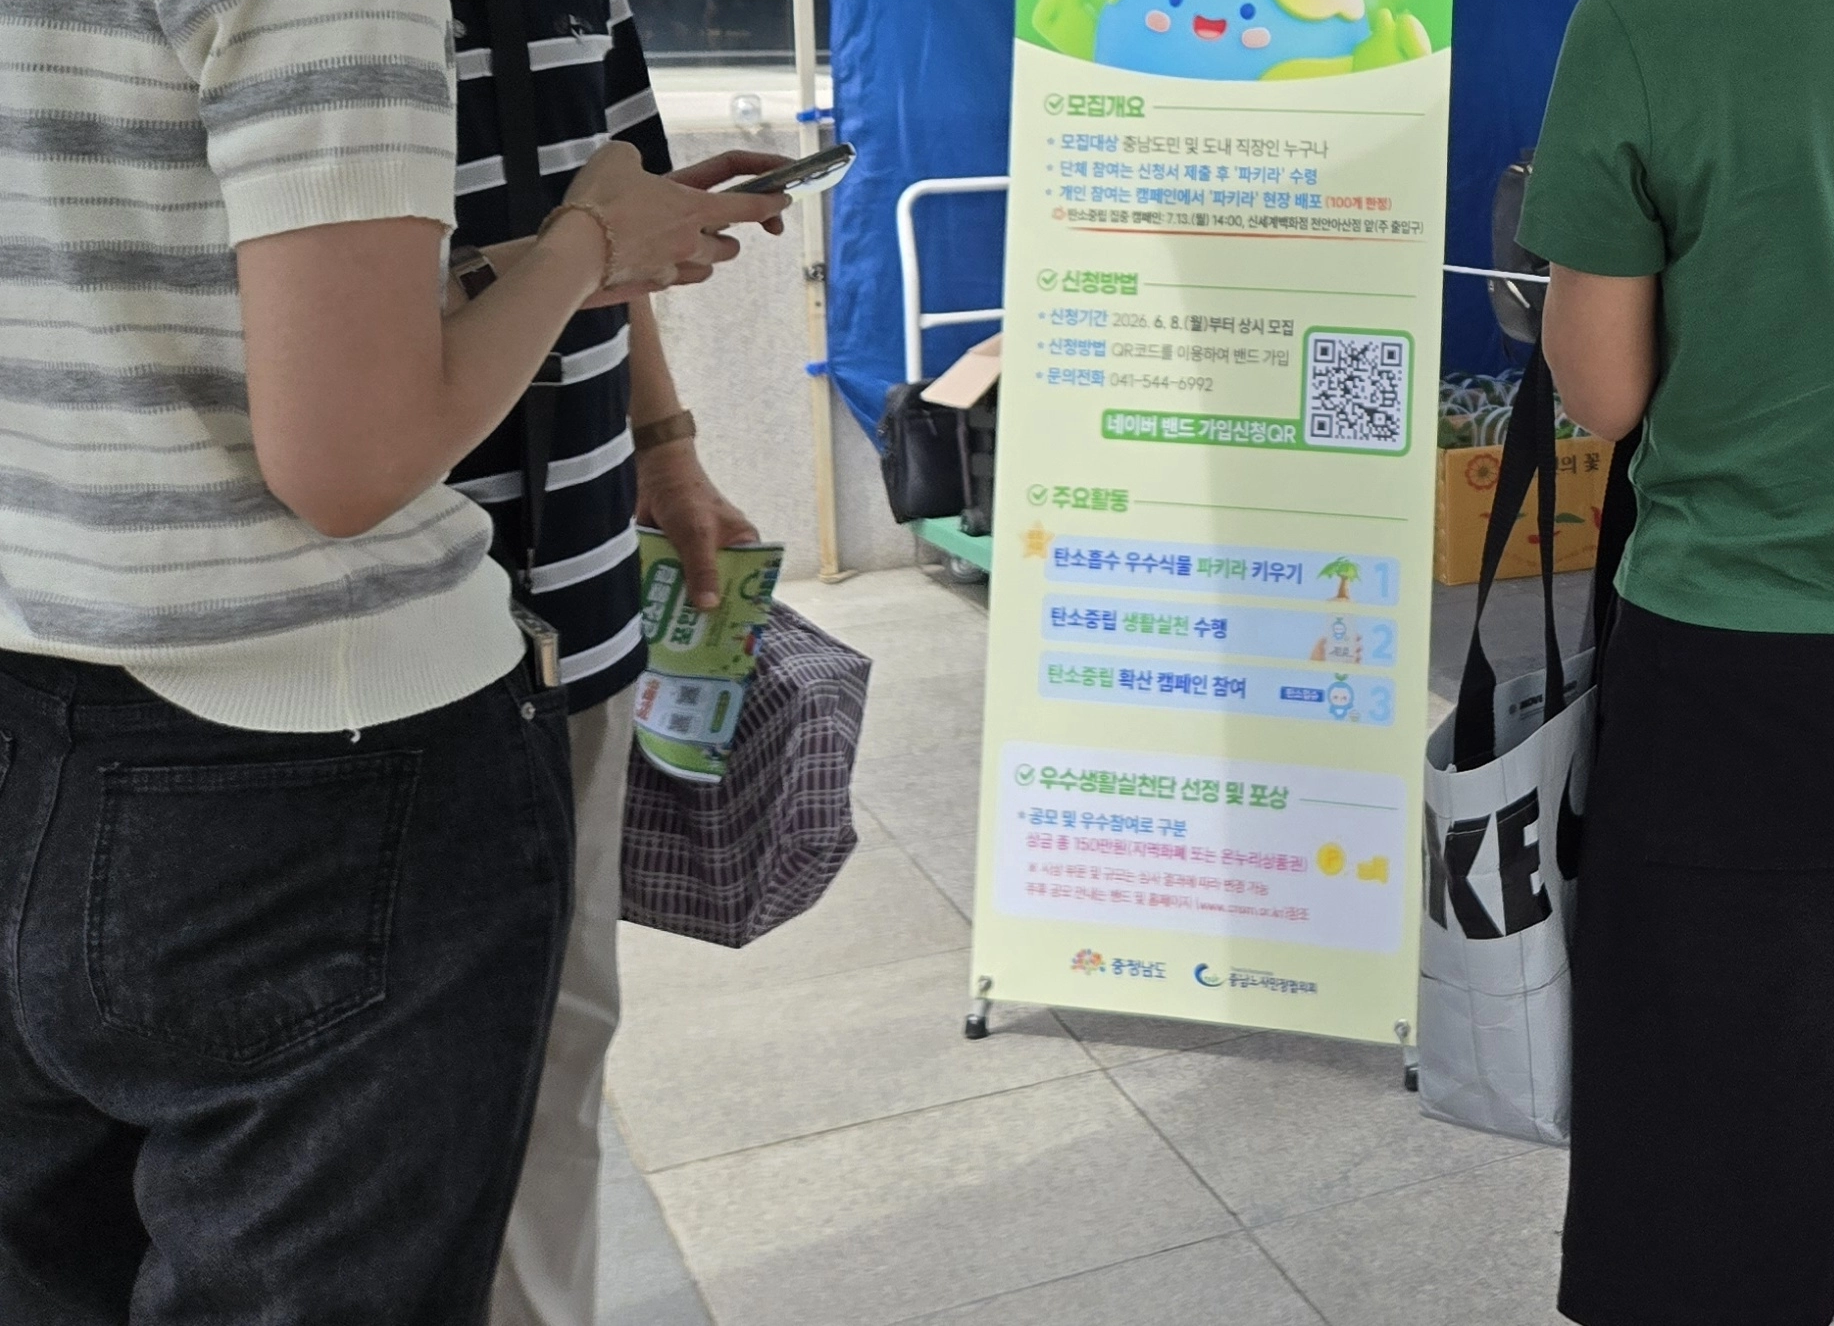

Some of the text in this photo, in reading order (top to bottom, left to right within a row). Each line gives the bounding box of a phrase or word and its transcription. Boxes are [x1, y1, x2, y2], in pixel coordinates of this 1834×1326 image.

[1066, 93, 1146, 119] 모집개요
[1061, 133, 1329, 159] 모집대상 충남도민 및 도내 직장인 누구나
[1060, 160, 1088, 178] 단체
[1092, 161, 1134, 180] 참여는
[1138, 163, 1180, 181] 신청서
[1184, 164, 1212, 183] 제출
[1215, 165, 1231, 183] 후
[1289, 167, 1318, 186] 수령
[1060, 184, 1087, 202] 개인
[1090, 185, 1132, 204] 참여는
[1136, 186, 1205, 206] 캠페인에서
[1263, 192, 1291, 210] 현장
[1294, 193, 1323, 210] 배포
[1061, 271, 1139, 296] 신청방법
[1050, 308, 1109, 328] 신청기간
[1112, 312, 1150, 328] 2026.
[1238, 318, 1265, 335] 상시
[1267, 319, 1295, 337] 모집
[1048, 338, 1290, 367] 신청방법 QR코드를 이용하여 밴드 가입
[1047, 367, 1214, 392] 문의전화 041-544-6992
[1106, 413, 1297, 444] 네이버 밴드 가입신청QR
[1052, 485, 1130, 513] 주요활동
[1125, 551, 1192, 576] 우수식물
[1196, 557, 1248, 581] 파키라
[1251, 560, 1303, 585] 키우기
[1373, 562, 1390, 599] 1
[1050, 606, 1118, 632] 탄소중립
[1121, 611, 1190, 637] 생활실천
[1193, 616, 1229, 640] 수행
[1371, 623, 1394, 660] 2
[1047, 663, 1115, 689] 탄소중립
[1118, 668, 1153, 692] 확산
[1156, 672, 1208, 696] 캠페인
[1211, 675, 1248, 700] 참여
[1369, 685, 1392, 722] 3
[1039, 765, 1290, 810] 우수생활실천단 선정 및 포상
[1029, 806, 1059, 825] 공모
[1061, 810, 1077, 828] 및
[1157, 818, 1188, 839] 구분
